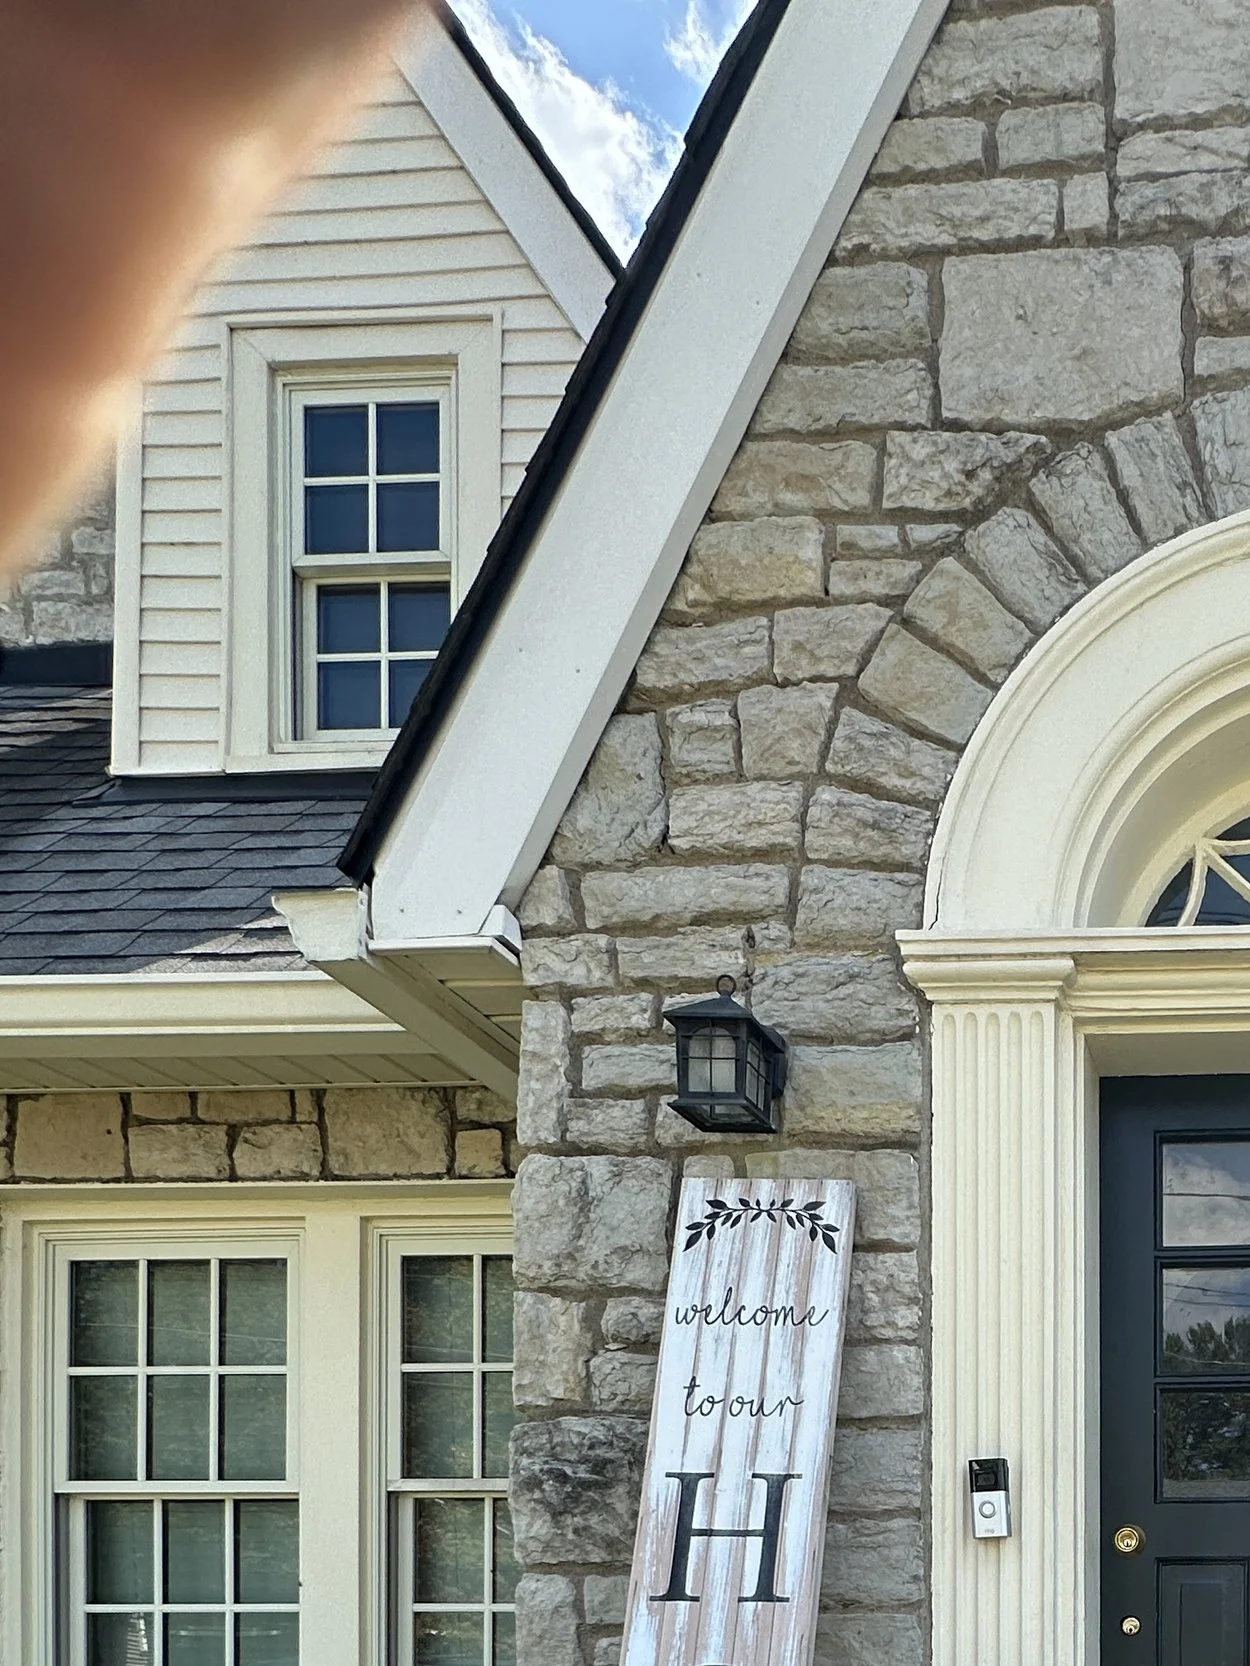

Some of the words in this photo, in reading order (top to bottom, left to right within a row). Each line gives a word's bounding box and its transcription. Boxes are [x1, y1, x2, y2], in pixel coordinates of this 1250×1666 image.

[675, 1286, 829, 1327] welcome
[683, 1376, 725, 1417] to
[729, 1395, 805, 1417] our
